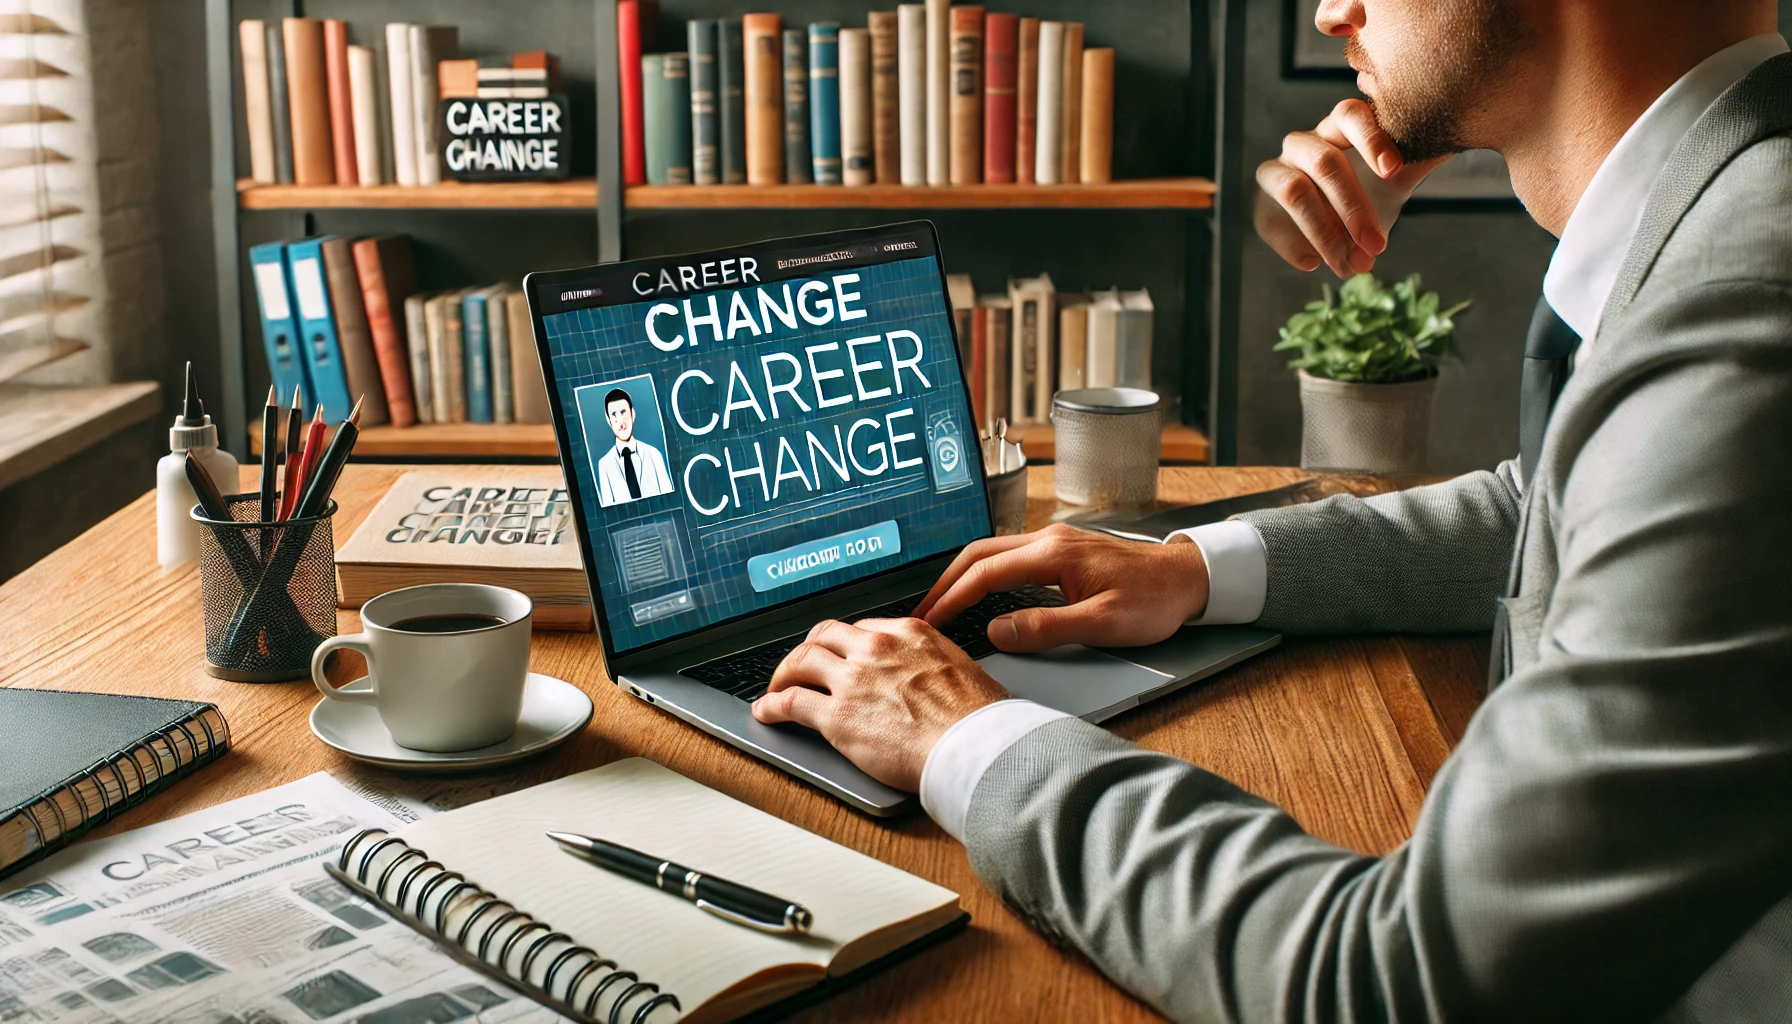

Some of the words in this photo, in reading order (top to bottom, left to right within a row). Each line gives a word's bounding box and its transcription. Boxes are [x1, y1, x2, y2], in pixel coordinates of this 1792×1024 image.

[446, 101, 562, 135] CAREER
[632, 257, 760, 296] CAREER
[645, 273, 867, 351] CHANGE
[671, 330, 931, 435] CAREER
[683, 408, 923, 516] CHANGE
